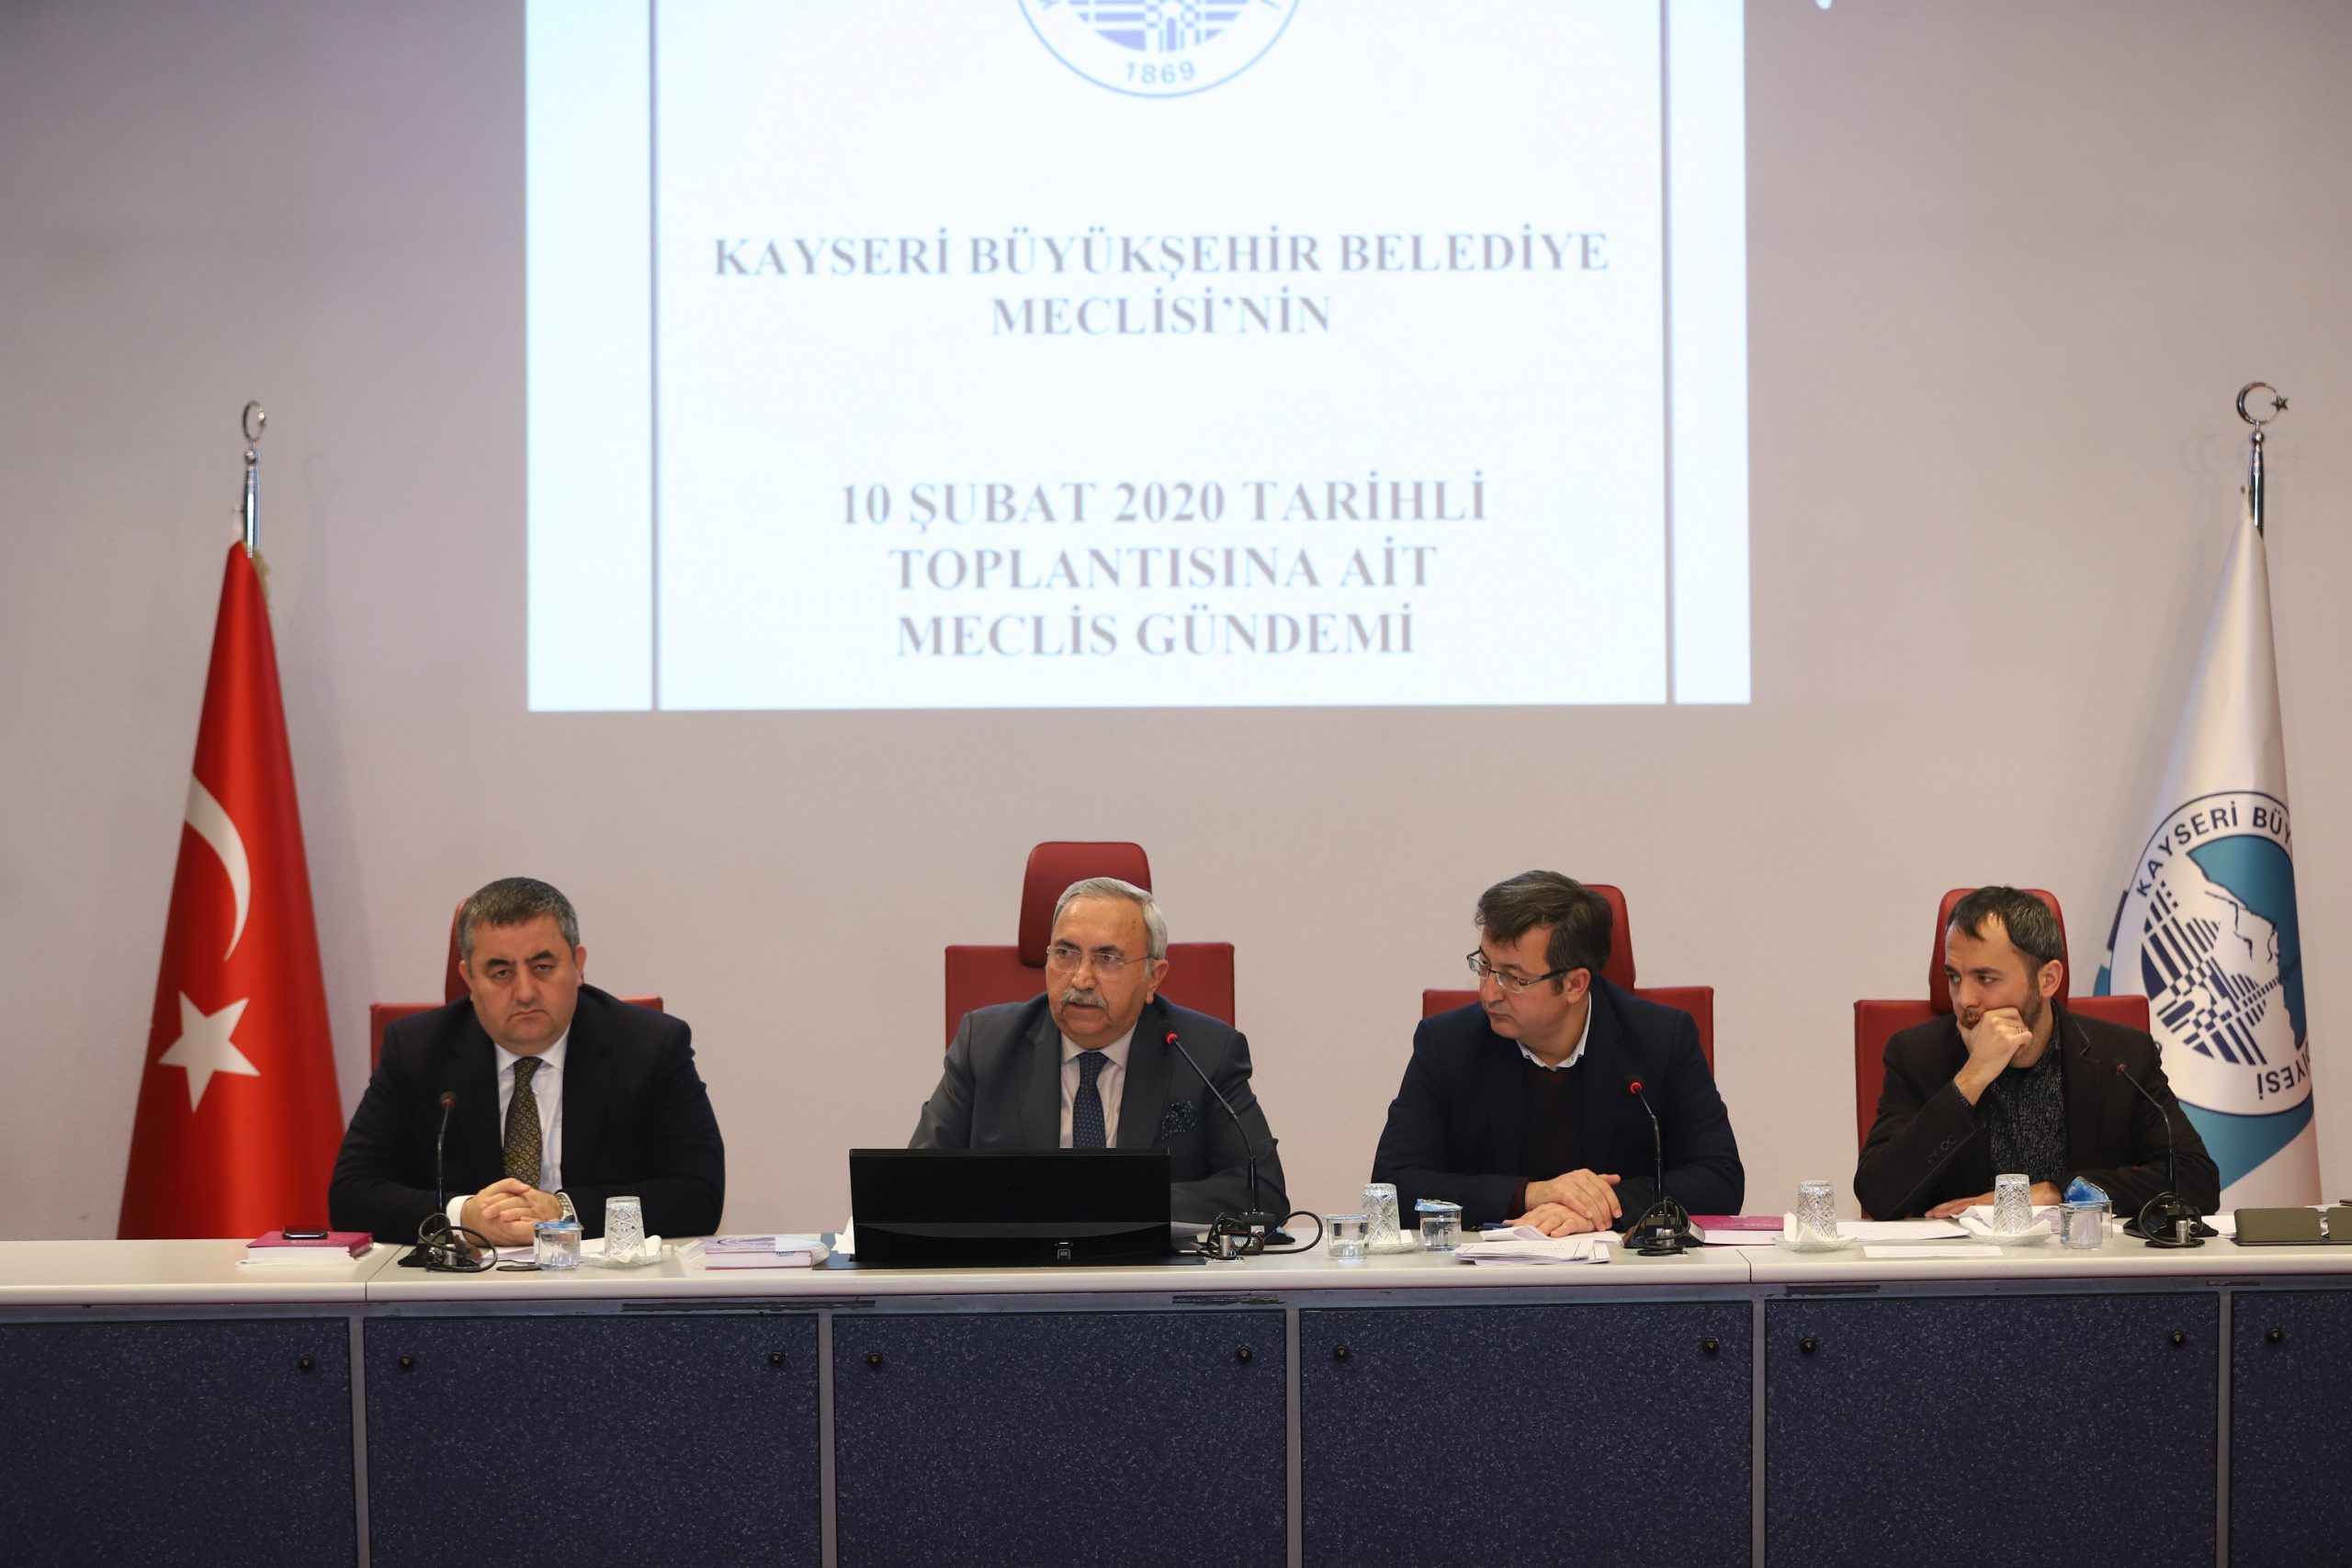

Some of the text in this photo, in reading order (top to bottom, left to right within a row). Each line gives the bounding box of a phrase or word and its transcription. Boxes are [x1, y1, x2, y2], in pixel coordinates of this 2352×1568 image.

[1125, 61, 1196, 85] 1869
[715, 224, 1610, 282] KAYSERİ BÜYÜKŞEHİR BELEDİYE
[843, 470, 1487, 535] 10 ŞUBAT 2020 TARİHLİ
[888, 536, 1440, 592] TOPLANTISINA AİT
[899, 603, 1414, 658] MECLİS GÜNDEMİ
[2136, 801, 2238, 897] KAYSERİ
